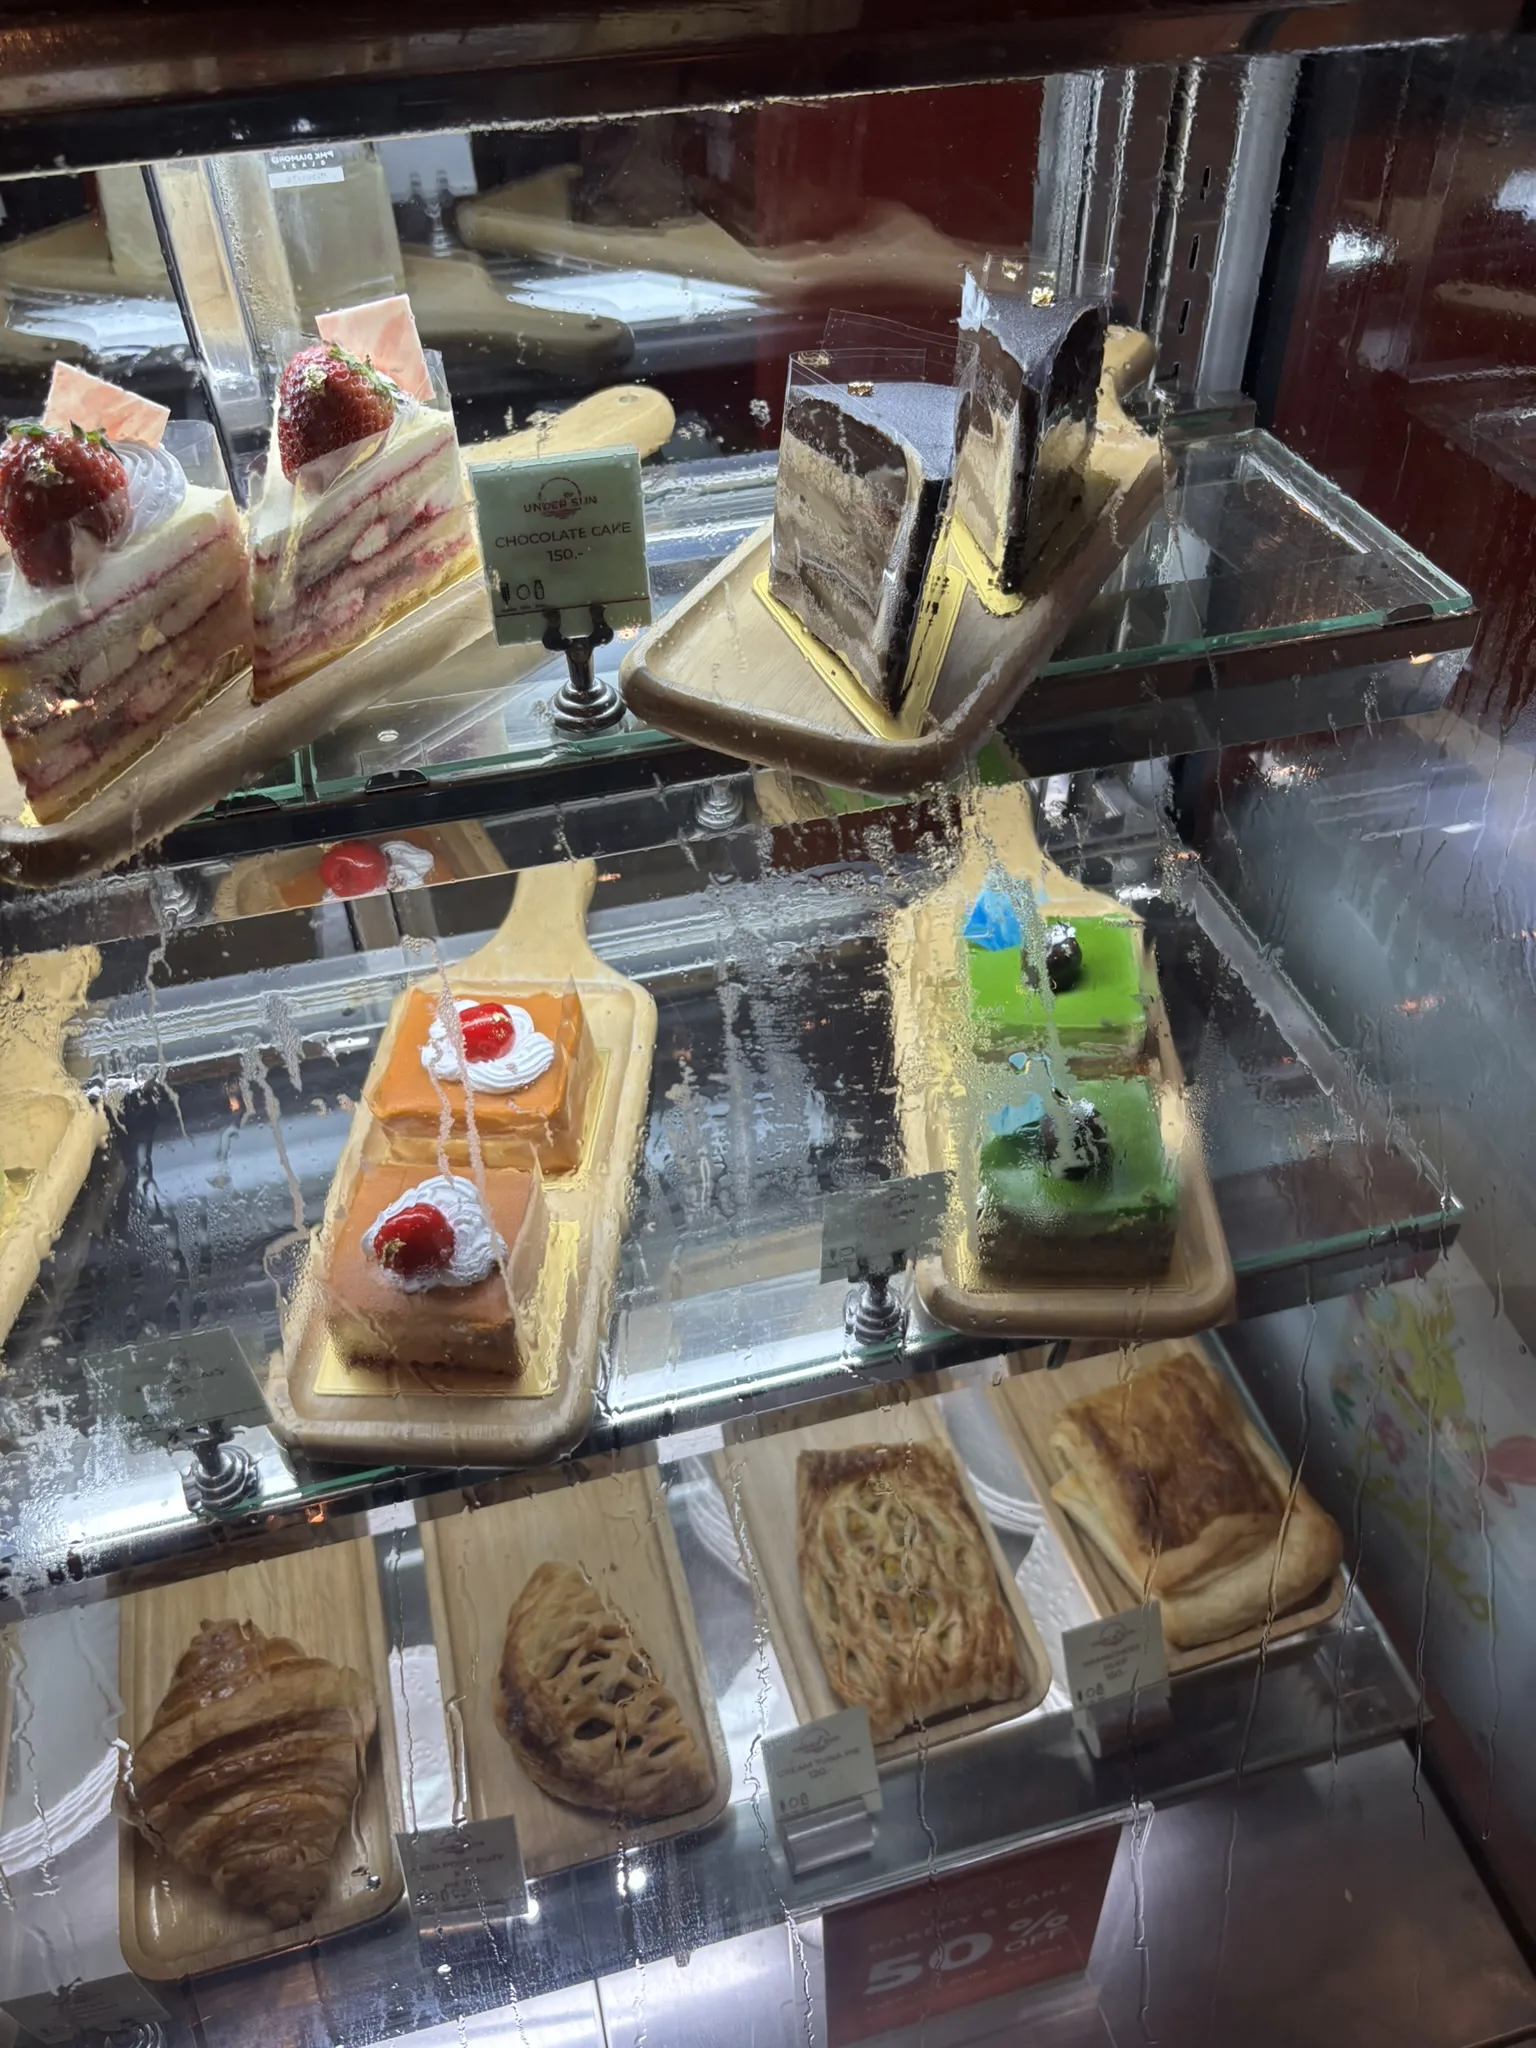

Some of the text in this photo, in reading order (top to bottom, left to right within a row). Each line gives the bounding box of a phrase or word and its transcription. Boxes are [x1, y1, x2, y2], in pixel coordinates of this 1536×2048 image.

[523, 499, 568, 514] UNDER
[495, 521, 632, 549] CHOCOLATE CAKE
[547, 548, 584, 563] 150.-
[776, 1761, 813, 1779] CREAM
[815, 1752, 843, 1767] TUNA
[868, 1915, 972, 1952] BAKERY
[1007, 1882, 1073, 1910] CAKE
[1004, 1925, 1067, 1952] OFF
[864, 1932, 994, 1996] 50
